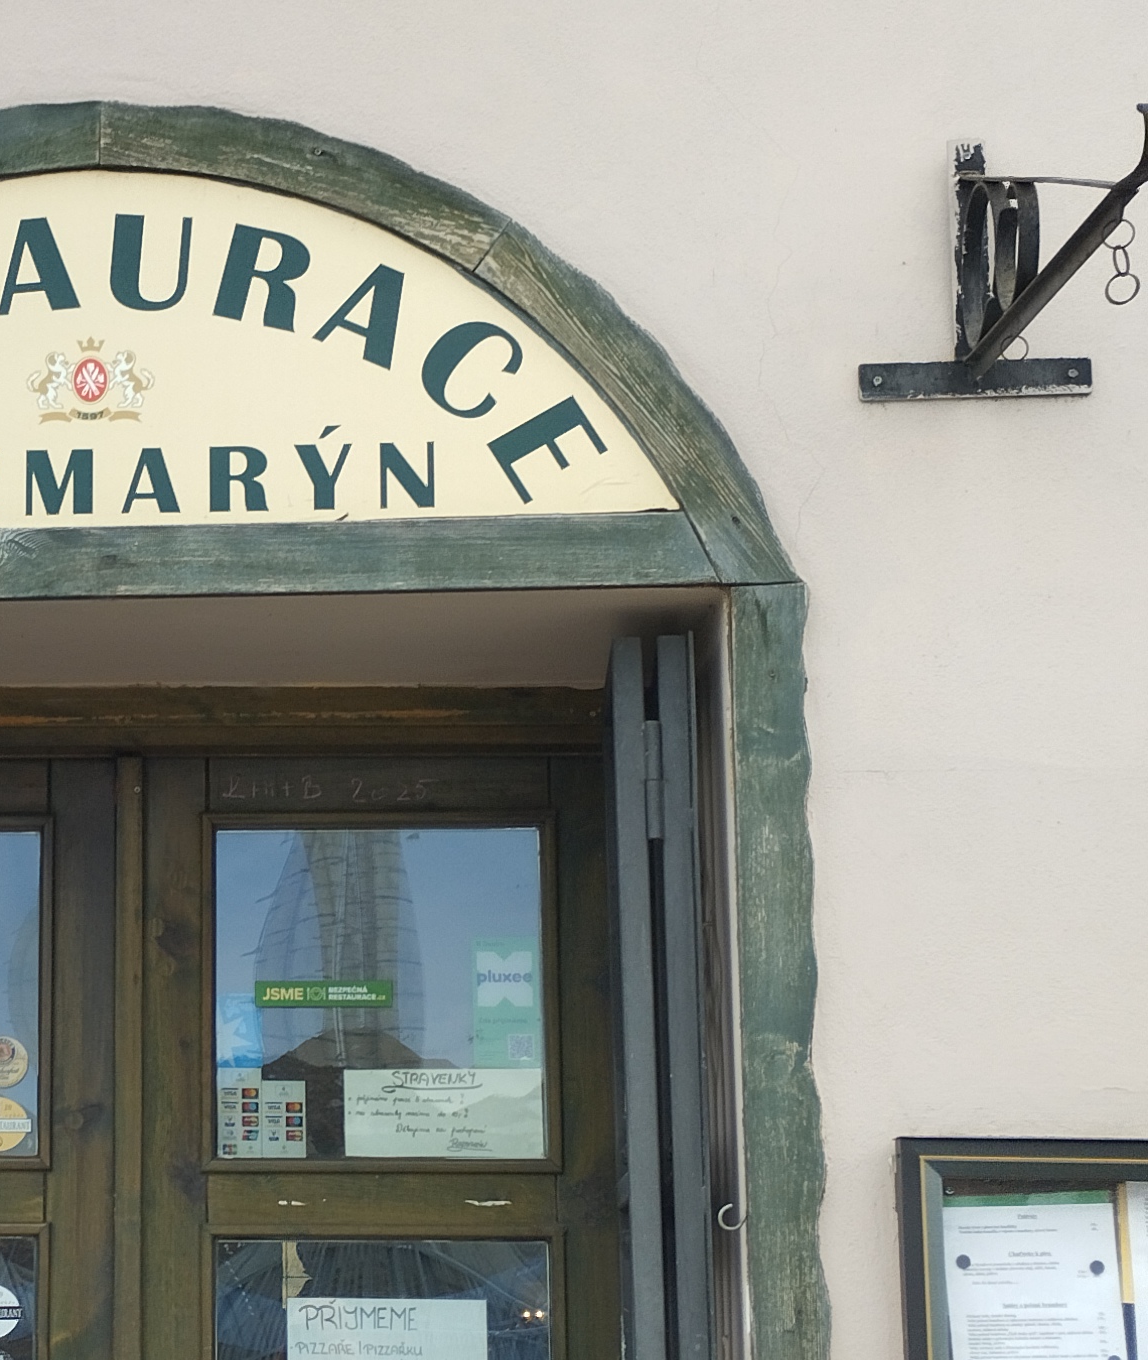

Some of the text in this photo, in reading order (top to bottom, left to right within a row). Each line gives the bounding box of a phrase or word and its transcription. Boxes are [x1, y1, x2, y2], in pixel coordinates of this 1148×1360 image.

[76, 410, 104, 421] 1597
[476, 969, 533, 987] pluxee
[262, 987, 304, 1001] JSME
[391, 1070, 476, 1087] STRAVENKY
